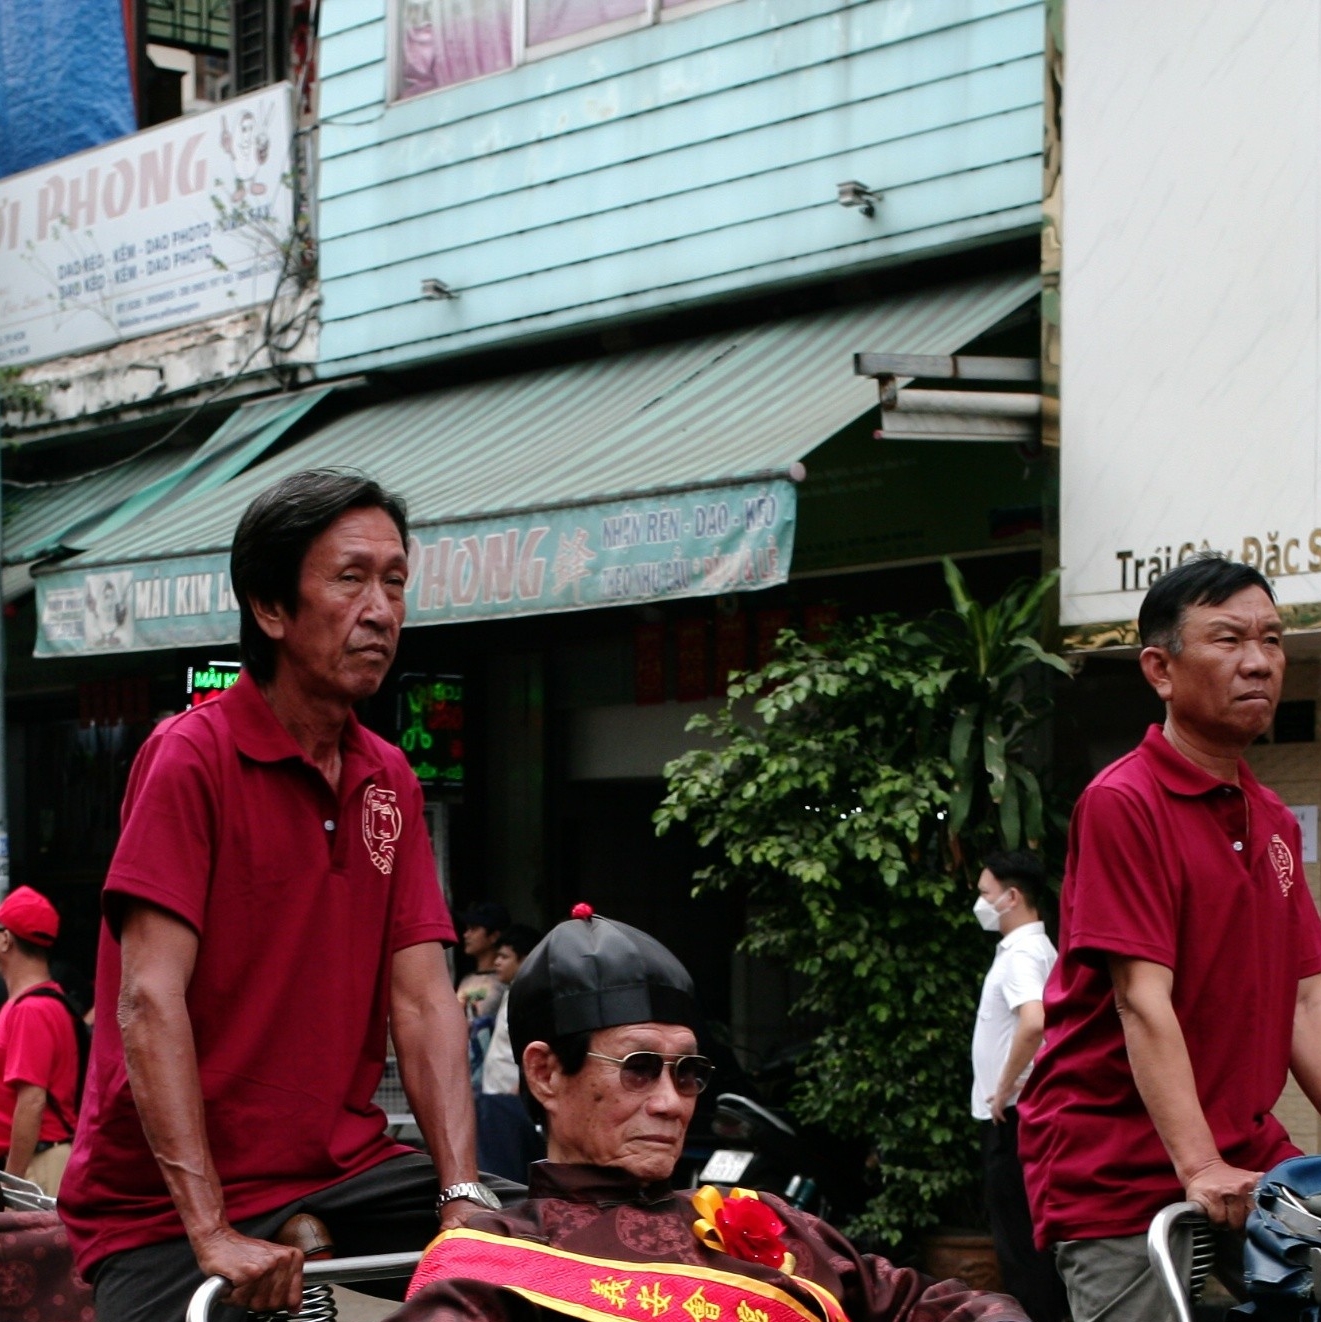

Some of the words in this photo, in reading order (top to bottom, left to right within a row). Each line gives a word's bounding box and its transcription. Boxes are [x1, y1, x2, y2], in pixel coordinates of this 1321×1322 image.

[36, 131, 209, 242] PHONG
[694, 502, 729, 540] DAO
[175, 573, 213, 617] KIM
